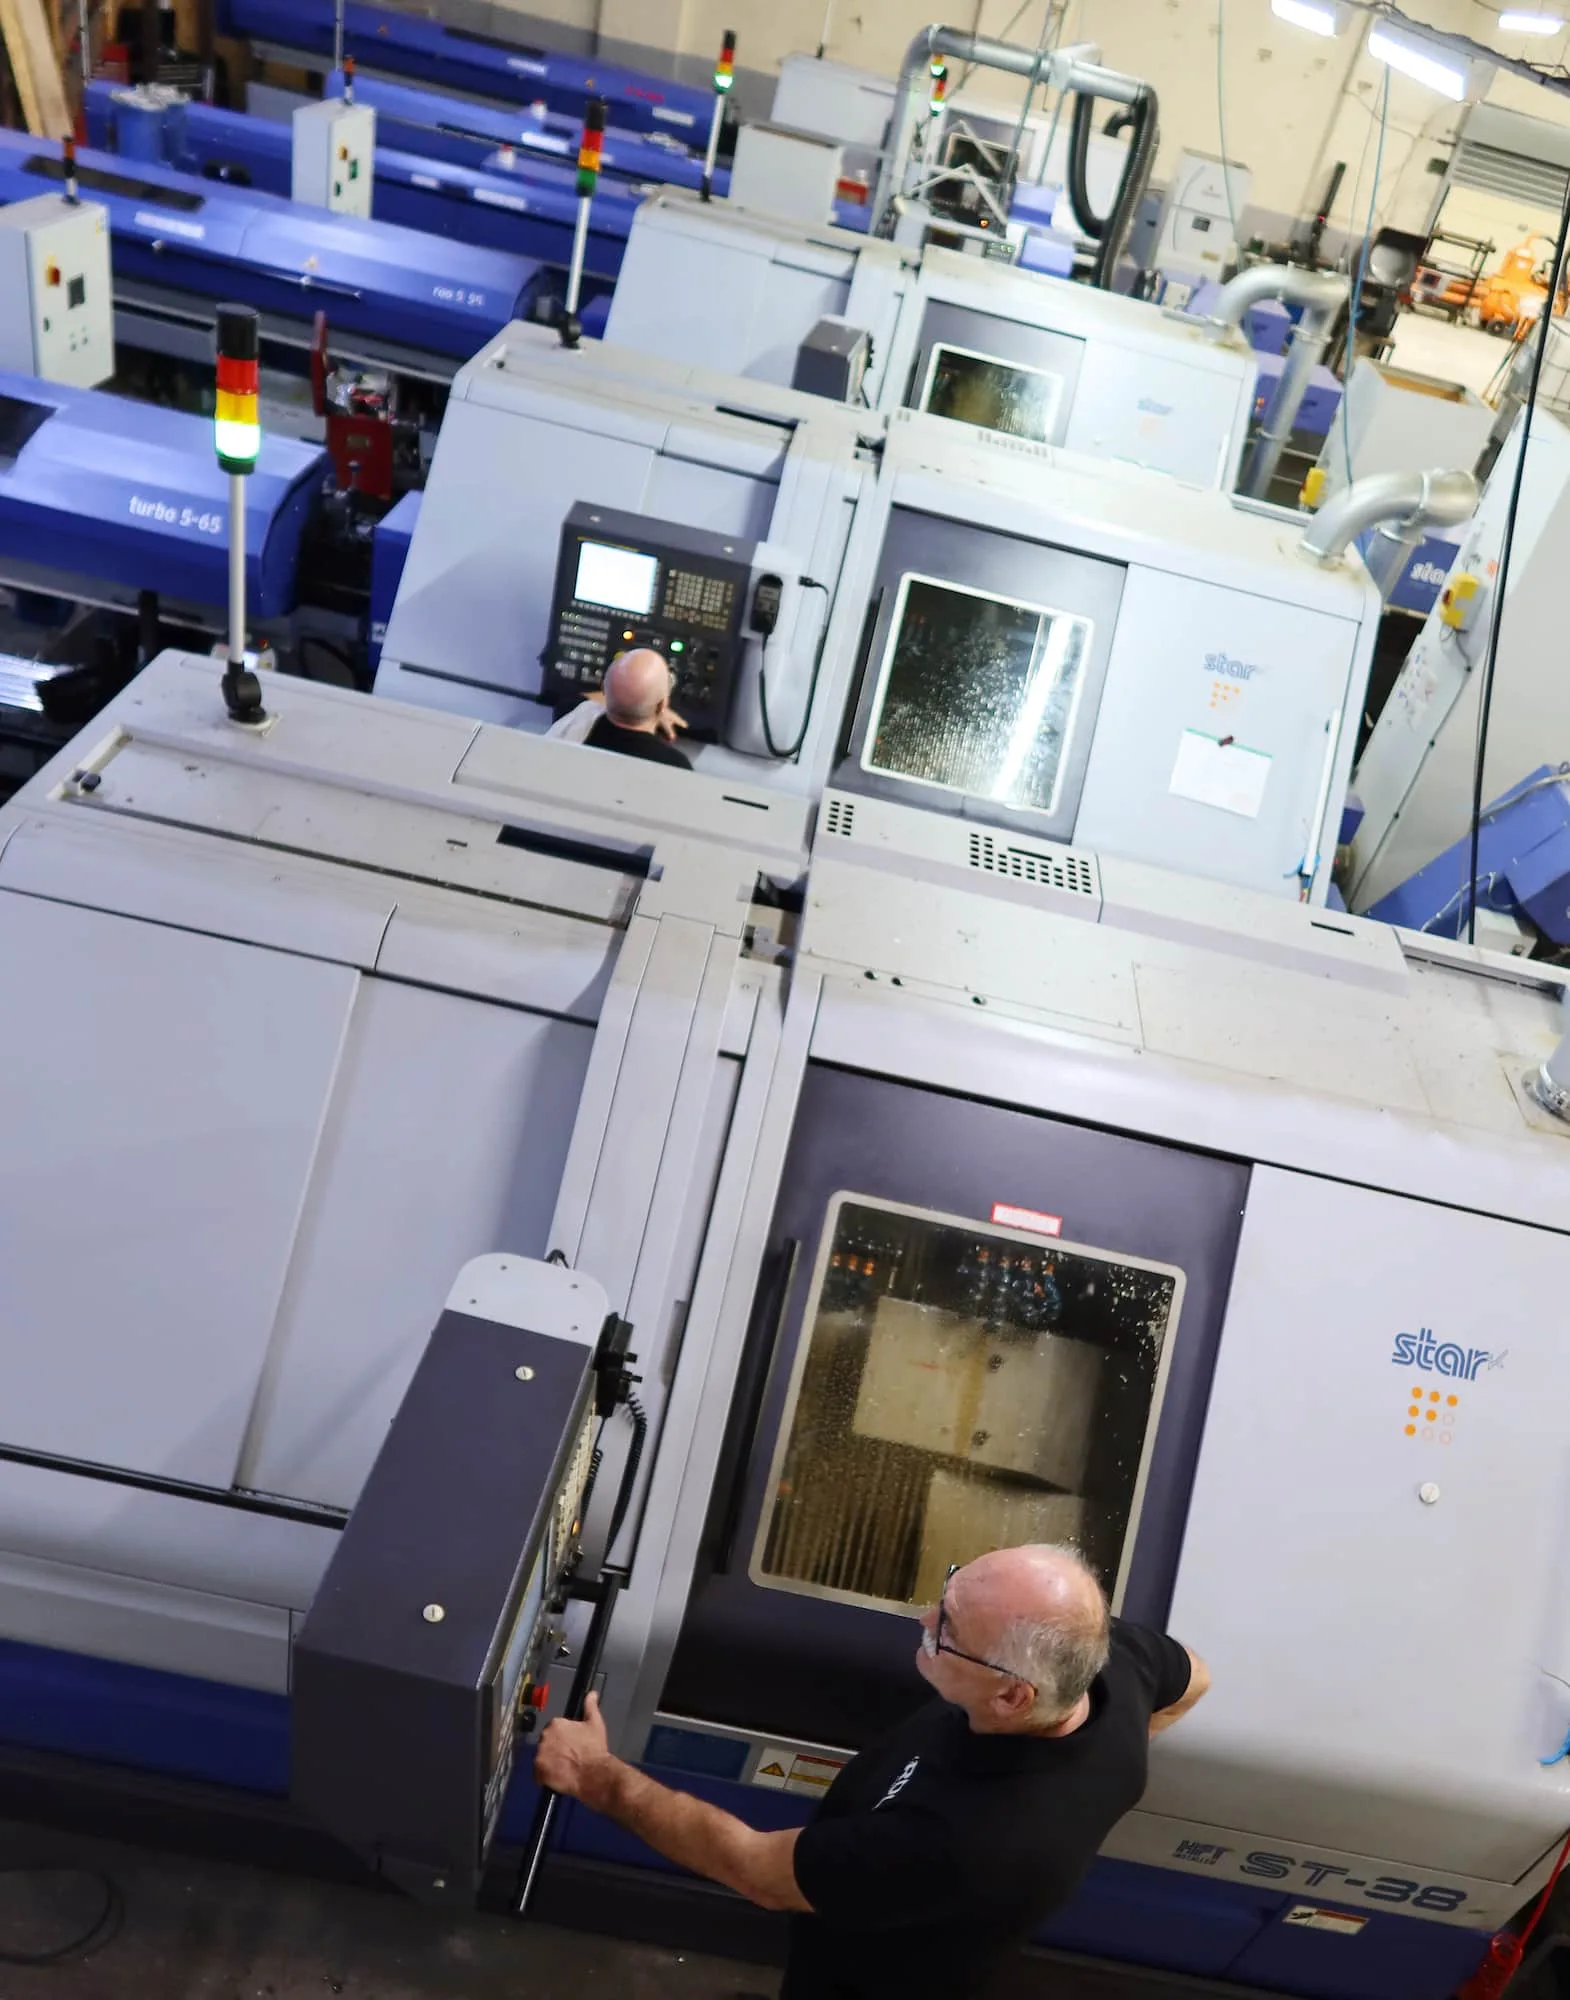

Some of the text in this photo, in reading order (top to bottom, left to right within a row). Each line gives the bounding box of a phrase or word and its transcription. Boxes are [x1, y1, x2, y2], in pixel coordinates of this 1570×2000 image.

[129, 495, 222, 534] turbo 5-65
[1410, 562, 1446, 586] sta
[1203, 652, 1257, 680] star
[1391, 1327, 1490, 1381] star
[1239, 1851, 1468, 1912] ST-38
